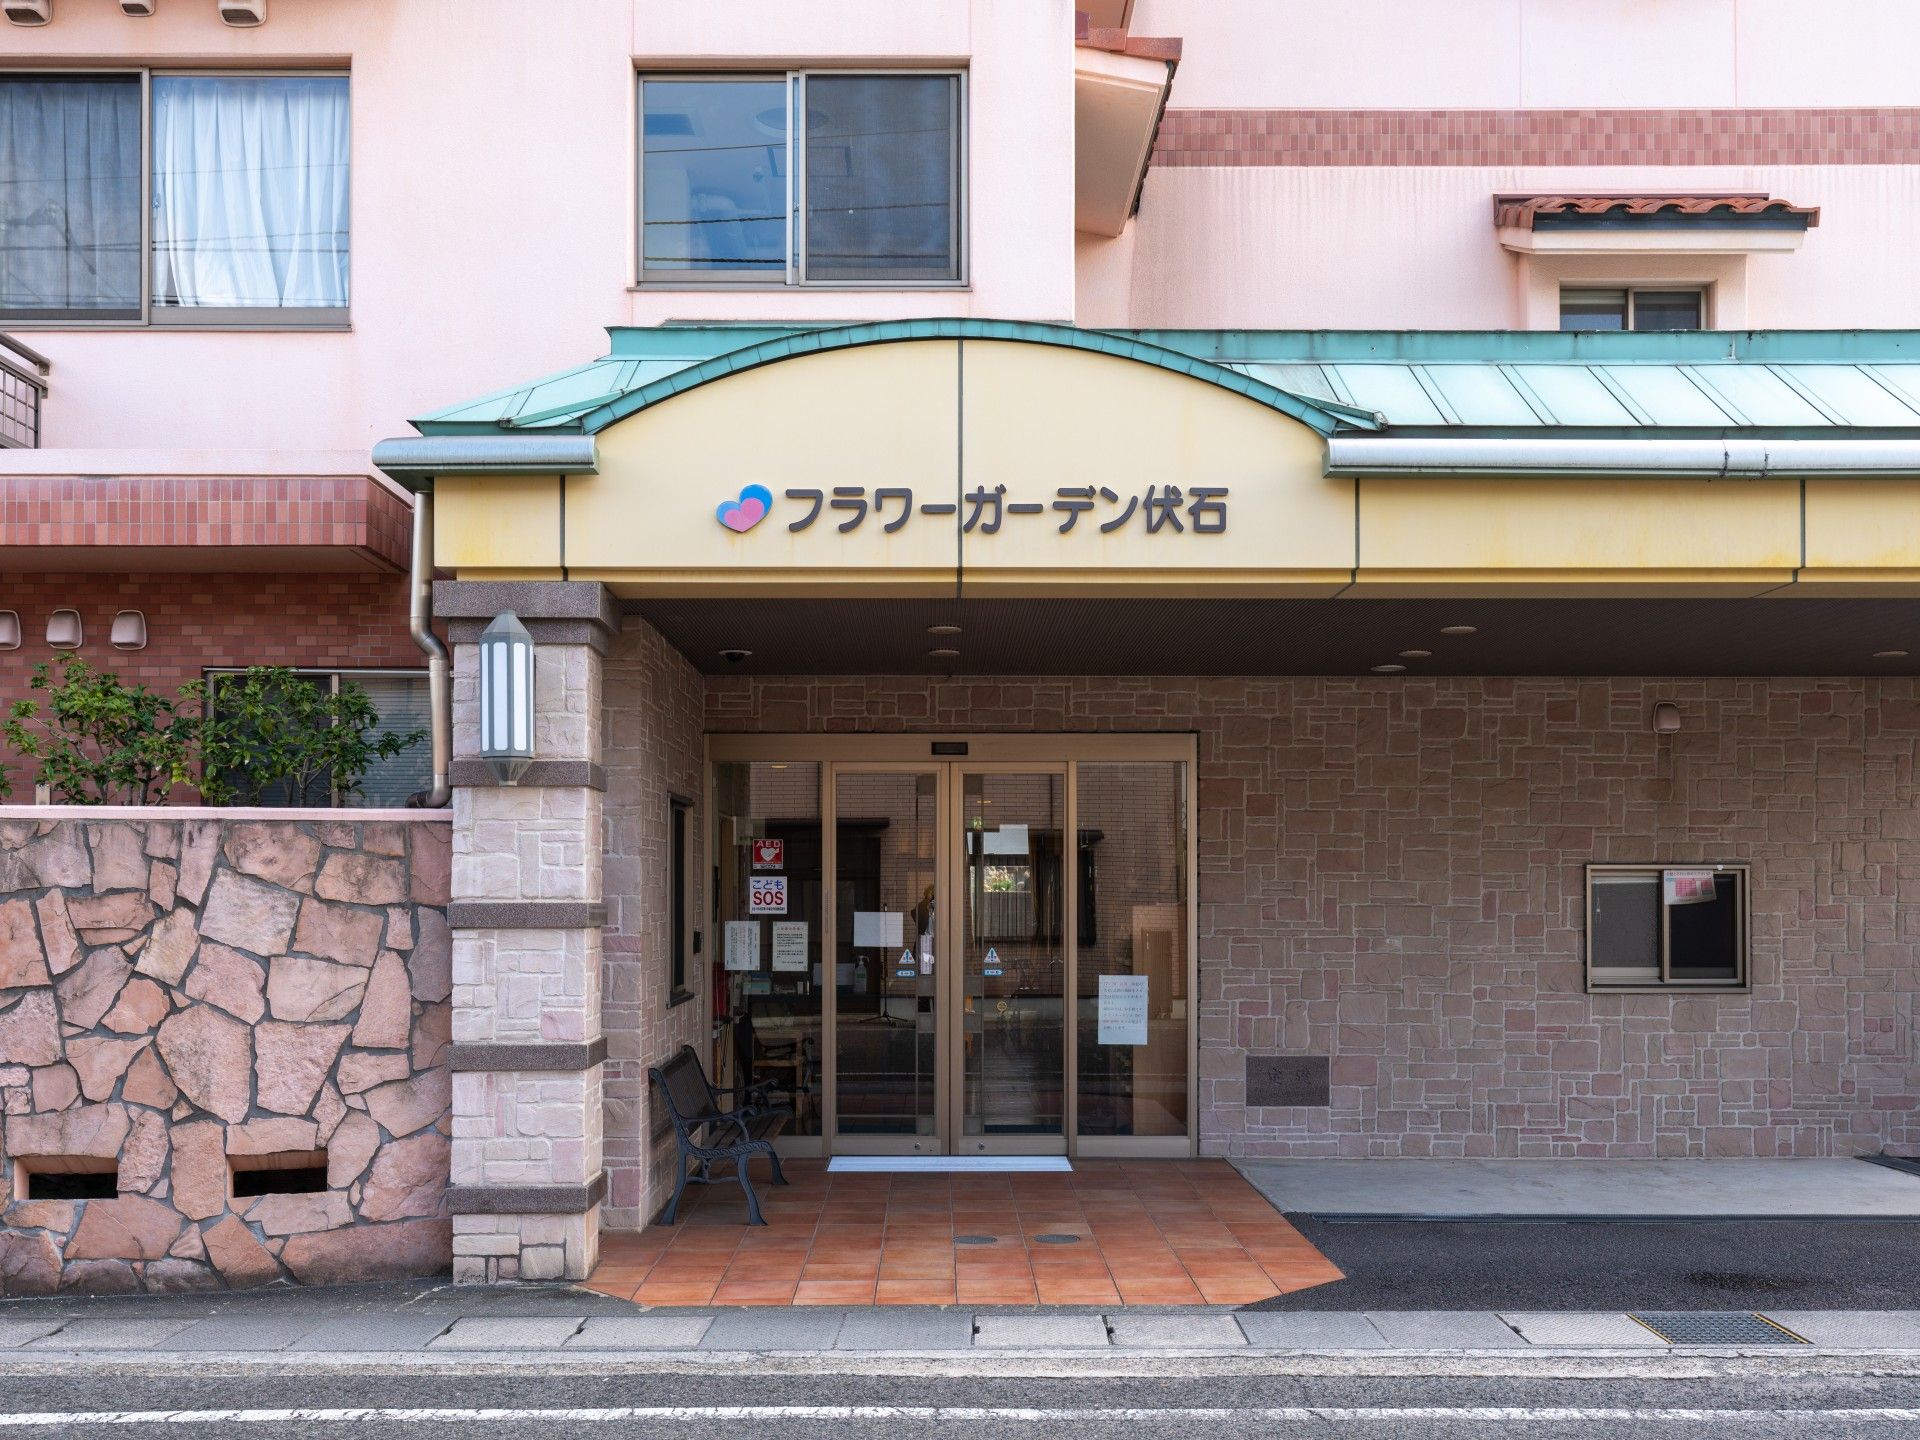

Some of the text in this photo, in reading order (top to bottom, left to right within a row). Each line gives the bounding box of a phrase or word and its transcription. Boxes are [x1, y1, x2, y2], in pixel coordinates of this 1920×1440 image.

[785, 484, 1229, 534] フラワーガーデン伏石
[756, 840, 781, 848] AED
[752, 879, 784, 890] こども
[753, 891, 783, 905] SOS
